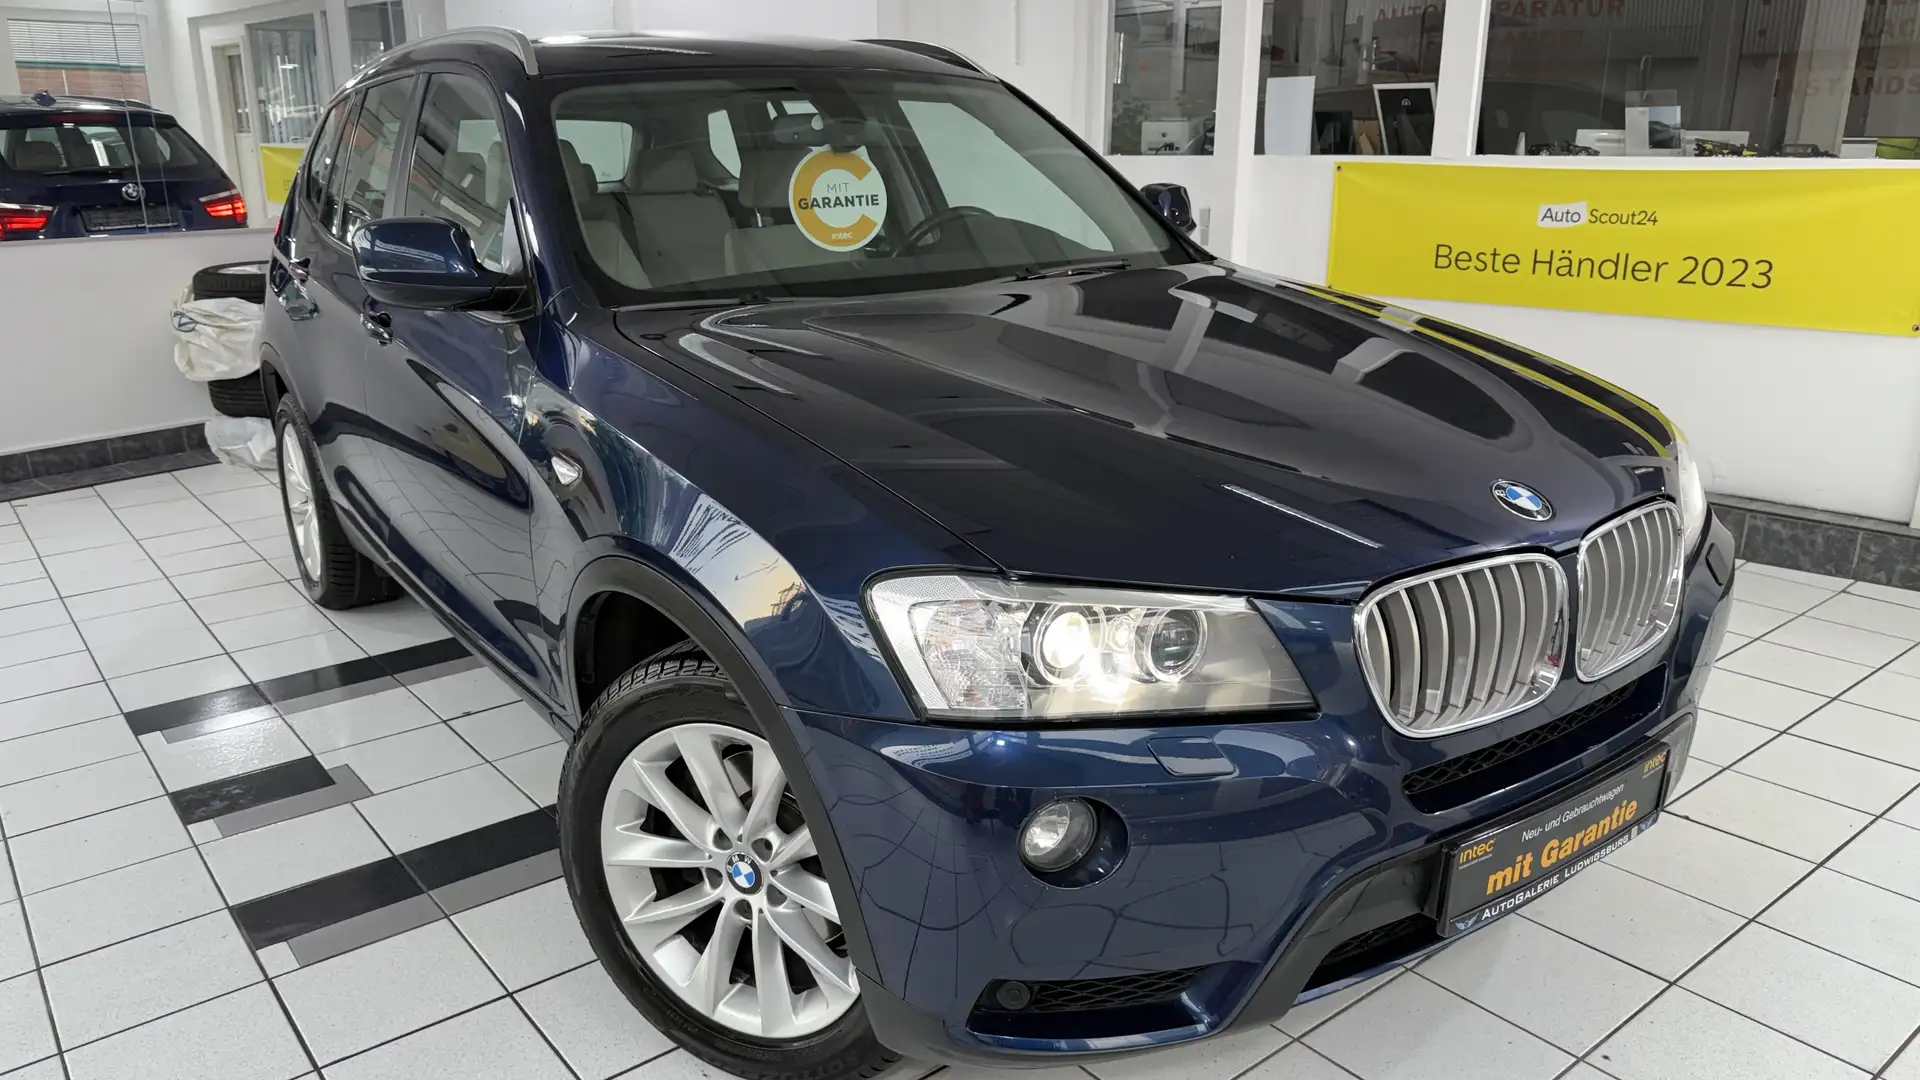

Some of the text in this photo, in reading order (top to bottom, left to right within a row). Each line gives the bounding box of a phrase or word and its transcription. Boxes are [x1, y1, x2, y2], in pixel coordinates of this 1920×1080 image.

[826, 182, 850, 194] MIT
[798, 194, 880, 210] GARANTIE
[1540, 207, 1659, 227] Auto Scout24
[1434, 243, 1774, 290] Beste Händler 2023
[1521, 783, 1625, 843] Neu- und Gebrauchtwagen
[1459, 839, 1495, 864] intec
[1486, 799, 1638, 896] mit Garantie
[727, 854, 753, 873] BMW
